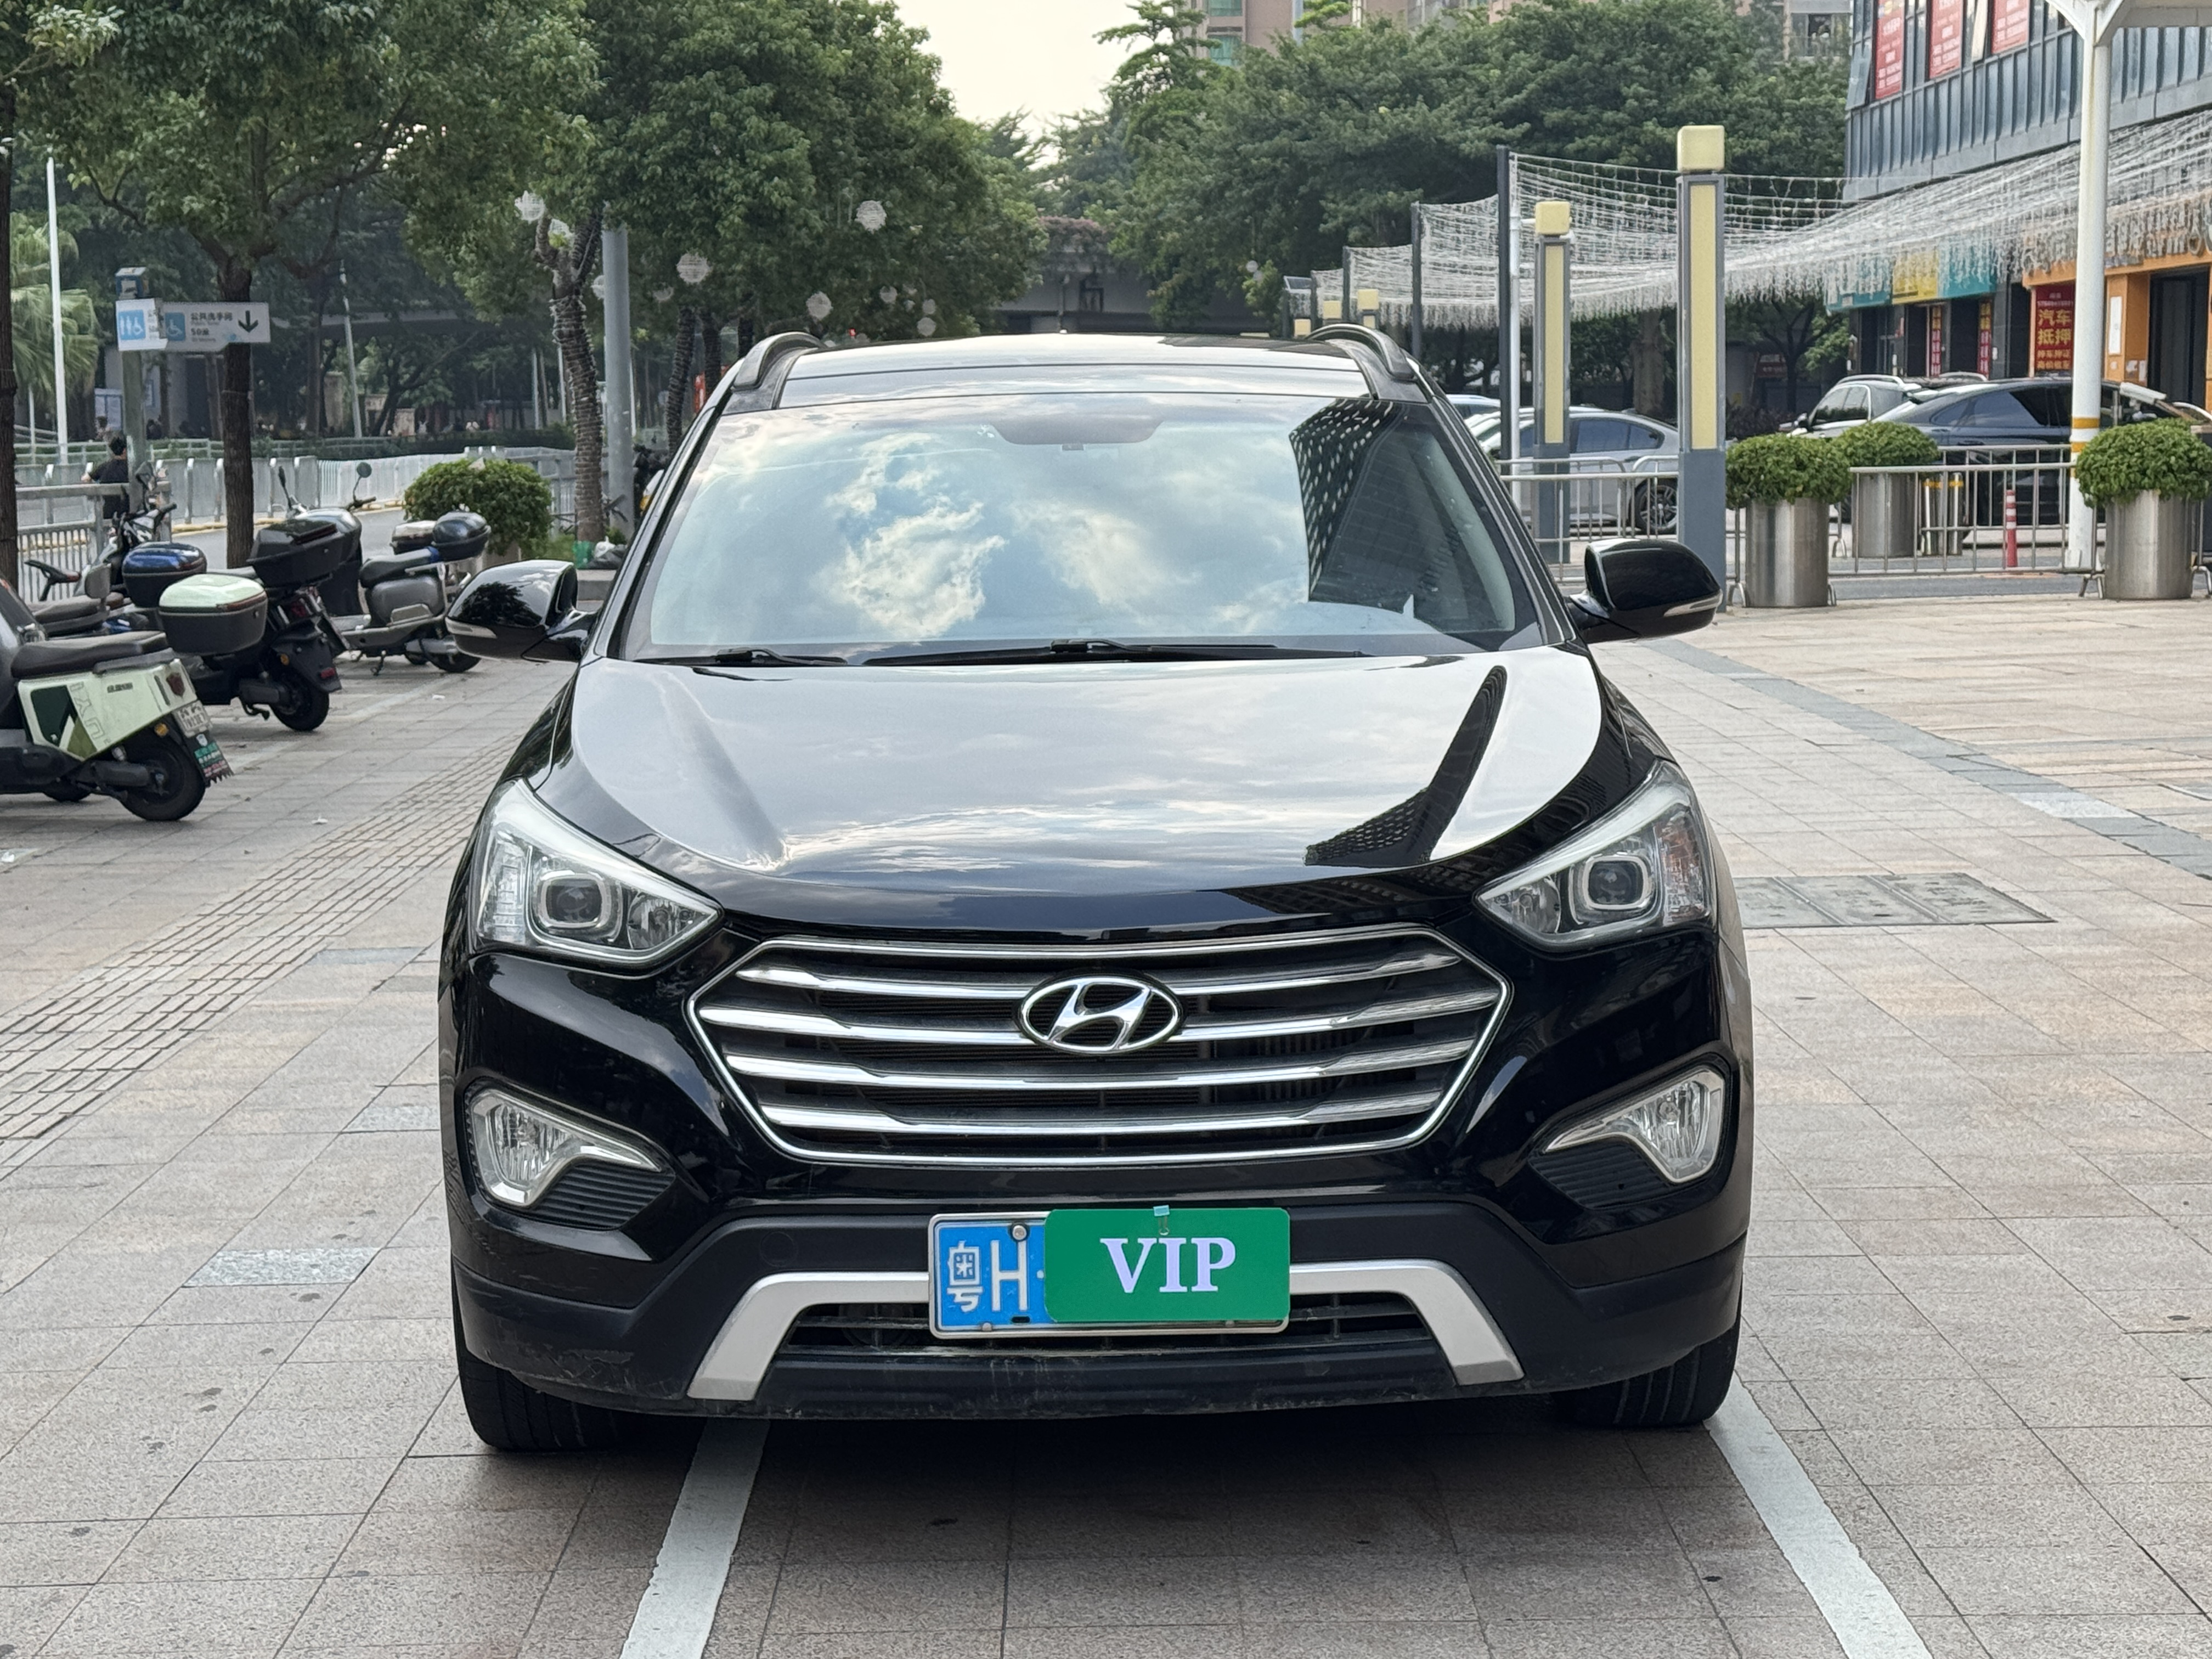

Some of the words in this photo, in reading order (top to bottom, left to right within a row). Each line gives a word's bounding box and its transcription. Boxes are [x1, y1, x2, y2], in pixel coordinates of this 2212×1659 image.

[2038, 309, 2072, 326] 汽车
[2038, 328, 2072, 345] 抵押
[1100, 1237, 1236, 1293] VIP
